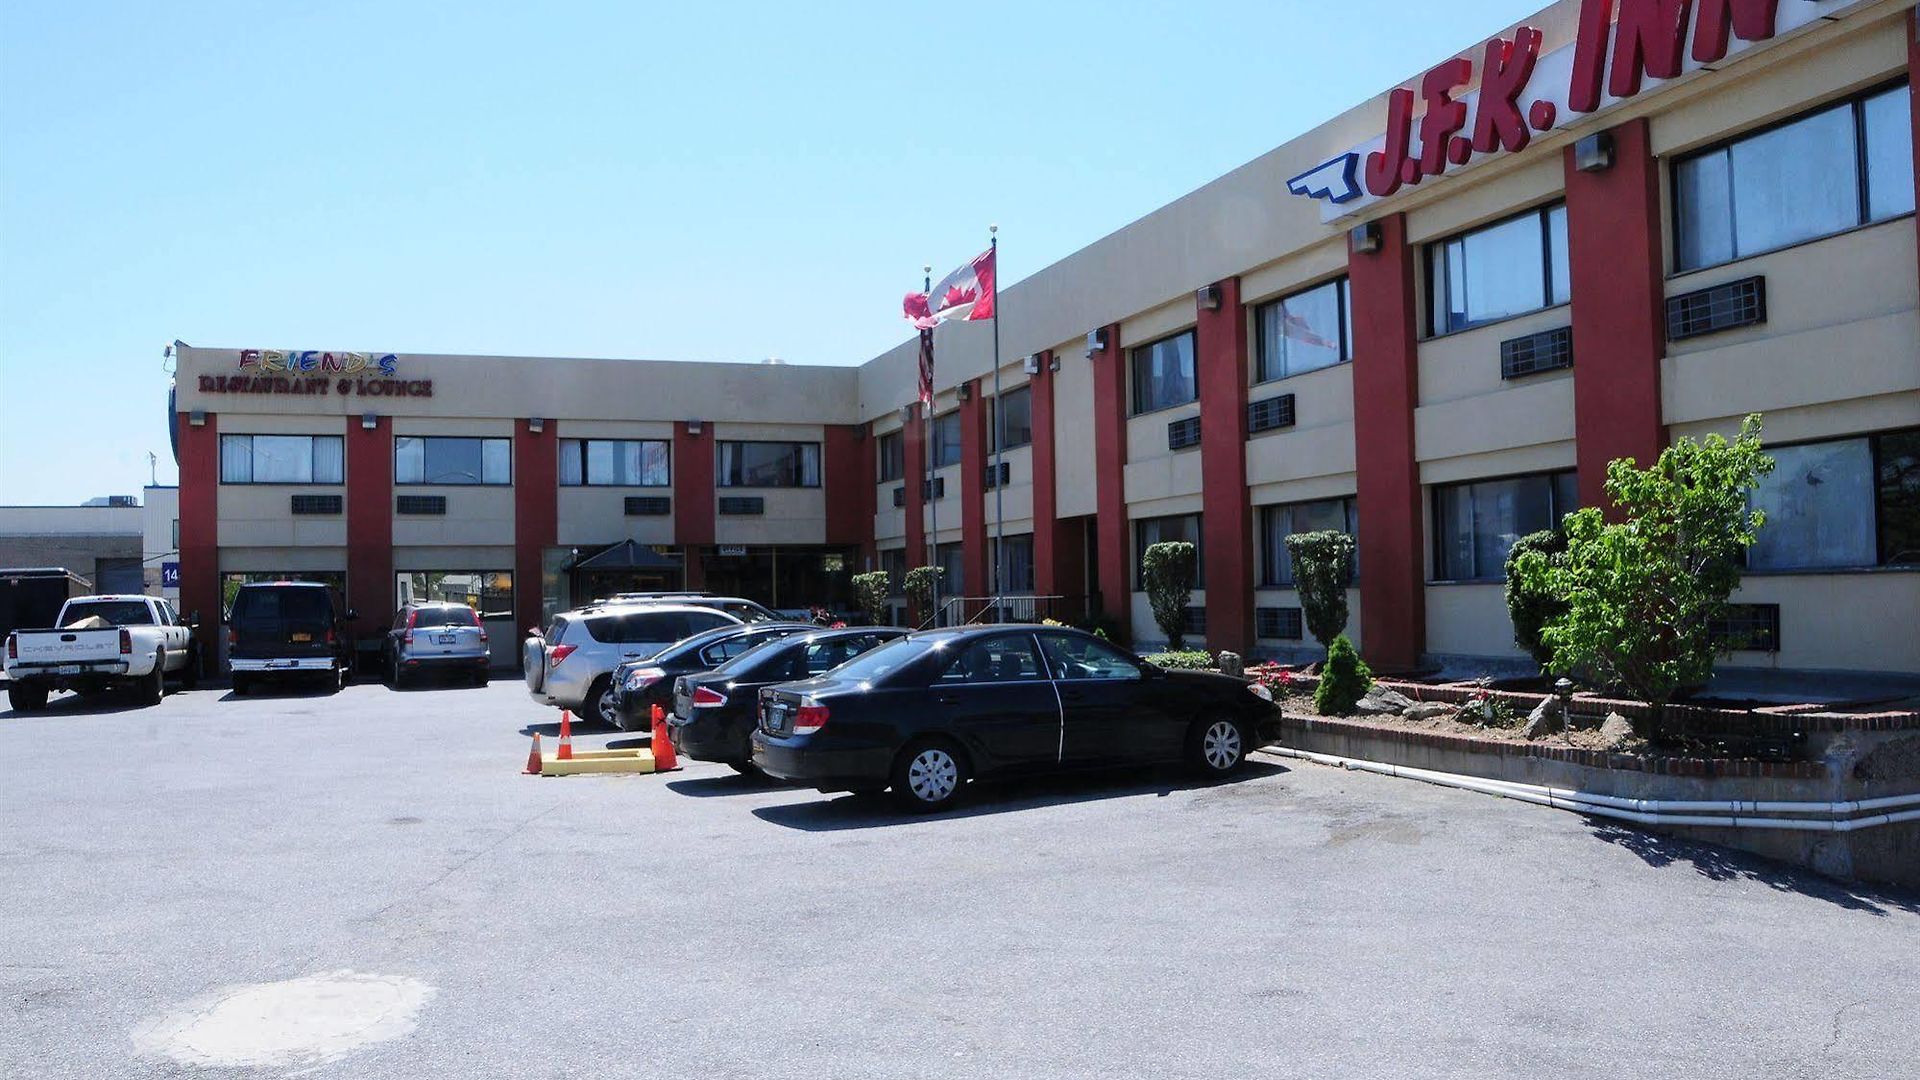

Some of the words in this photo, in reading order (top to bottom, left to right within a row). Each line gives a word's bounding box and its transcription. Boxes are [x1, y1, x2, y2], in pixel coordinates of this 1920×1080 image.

[199, 375, 330, 395] RESTAURANT
[336, 378, 351, 395] &
[356, 378, 432, 398] LOUNGE
[164, 569, 178, 582] 14
[23, 643, 114, 653] CHEVROLET
